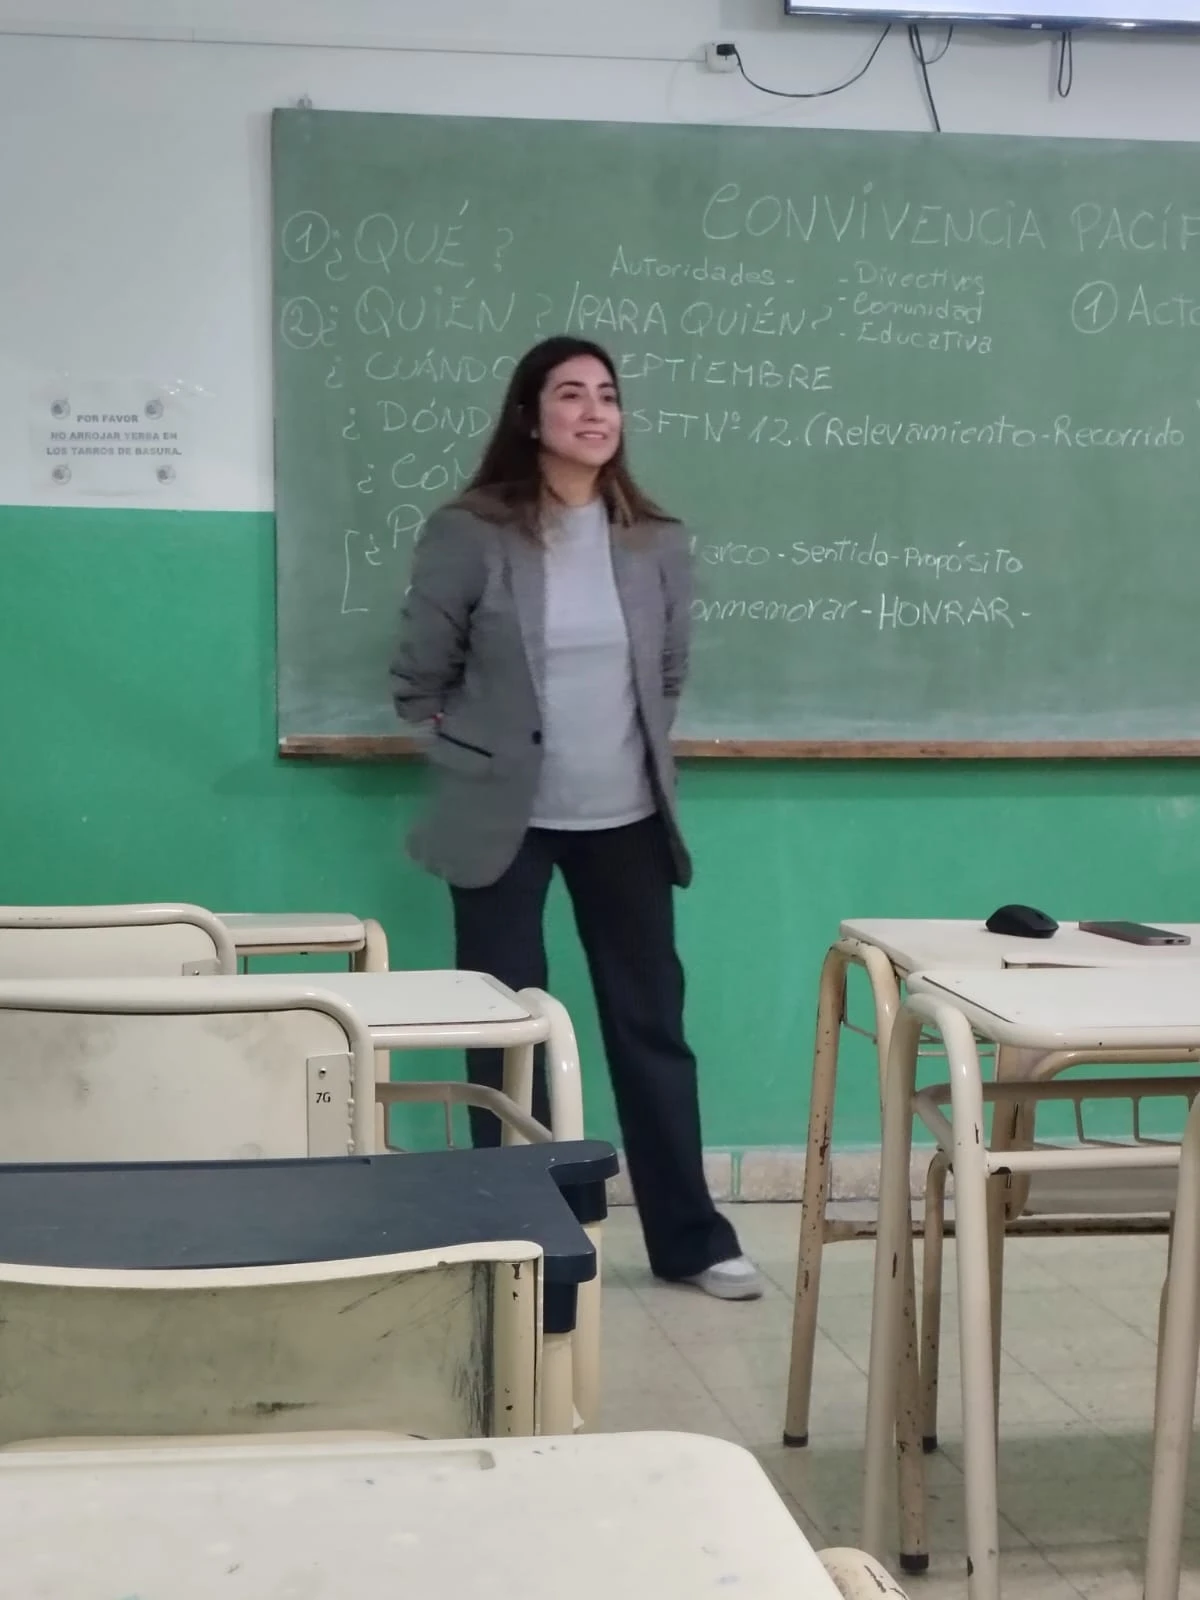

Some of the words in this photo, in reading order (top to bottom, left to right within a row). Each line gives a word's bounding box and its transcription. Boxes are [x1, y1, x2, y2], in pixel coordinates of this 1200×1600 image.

[609, 244, 776, 285] Autoridades
[856, 320, 993, 354] Educativa
[76, 414, 99, 423] POR
[102, 414, 139, 423] FAVOR
[50, 431, 67, 441] NO
[69, 431, 121, 441] ARROJAR
[46, 447, 68, 456] LOS
[71, 447, 115, 456] TARROS
[118, 447, 132, 456] DE
